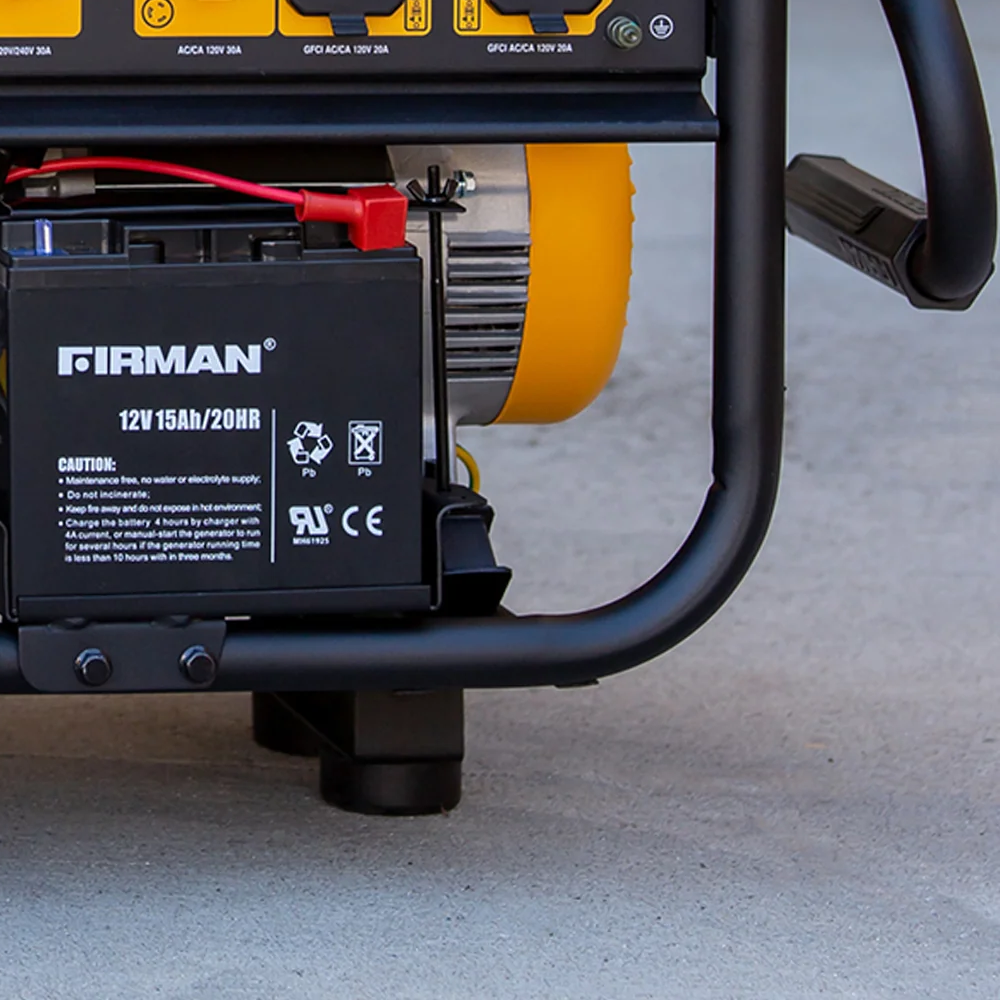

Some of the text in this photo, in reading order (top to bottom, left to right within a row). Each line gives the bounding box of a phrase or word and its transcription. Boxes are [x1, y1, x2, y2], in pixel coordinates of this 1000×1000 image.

[36, 46, 52, 56] 30A
[178, 45, 242, 55] AC/CA 120V 30A
[304, 44, 389, 54] GFCI AC/CA 120V 20A
[487, 43, 573, 53] GFCI AC/CA 120V 20A
[58, 457, 117, 472] CAUTION:
[302, 468, 317, 477] Pb
[358, 467, 372, 477] Pb
[66, 476, 120, 485] Maintenance
[154, 476, 176, 484] water
[177, 476, 186, 484] or
[188, 475, 230, 486] electrolyte
[67, 490, 81, 500] Do
[82, 490, 98, 500] not
[66, 516, 260, 529] Charge the battery 4 hours by charger with
[342, 505, 384, 537] CE
[178, 530, 192, 538] the
[194, 530, 234, 540] generator
[236, 529, 245, 537] to
[64, 540, 261, 551] for several hours if the generator running time
[64, 554, 72, 562] is
[74, 554, 92, 562] less
[92, 553, 112, 562] than
[113, 553, 124, 562] 10
[125, 553, 149, 562] hours
[150, 552, 168, 561] with
[169, 552, 178, 560] in
[178, 552, 200, 560] three
